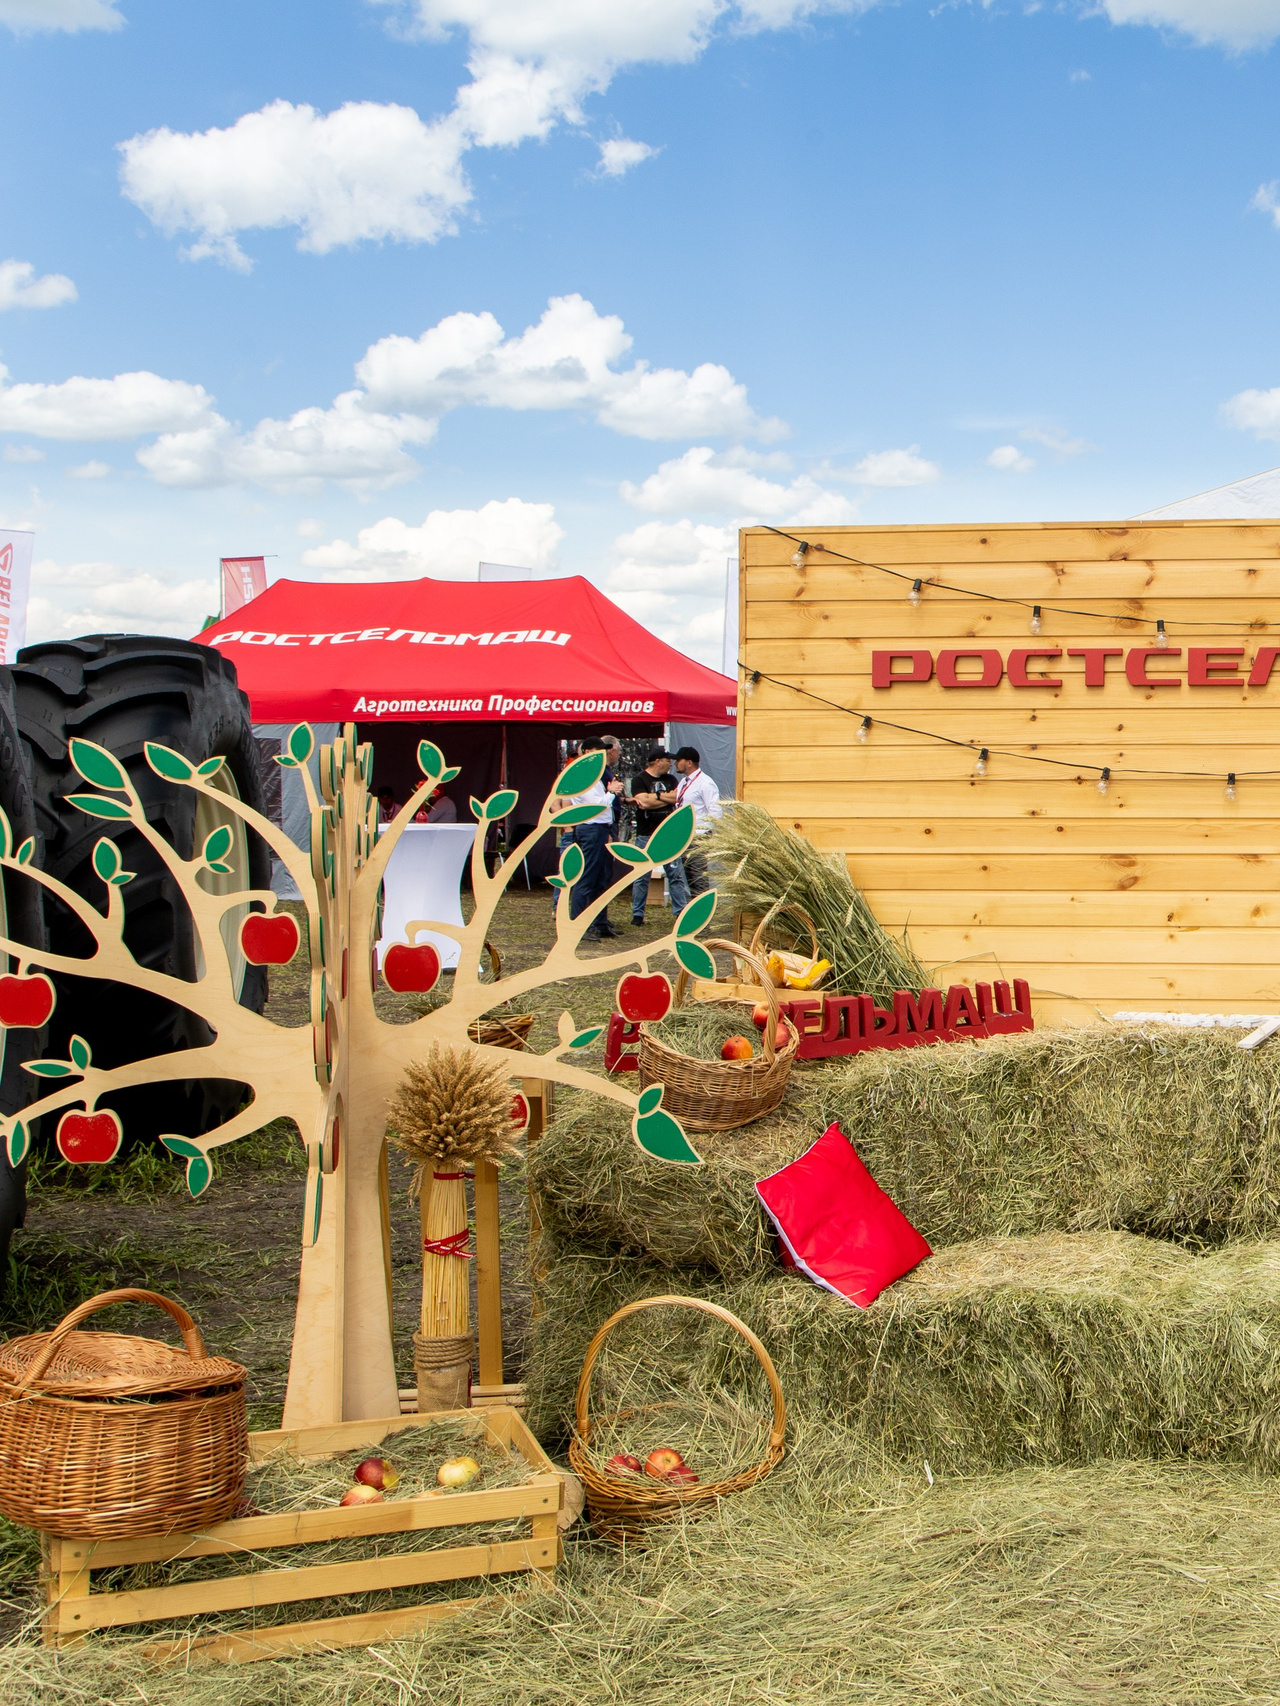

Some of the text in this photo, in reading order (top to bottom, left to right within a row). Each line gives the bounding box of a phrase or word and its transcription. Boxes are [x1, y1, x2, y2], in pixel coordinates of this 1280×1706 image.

[209, 628, 571, 646] РОСТСЕЛЬМАШ
[353, 695, 655, 716] Агротехника Профессионалов
